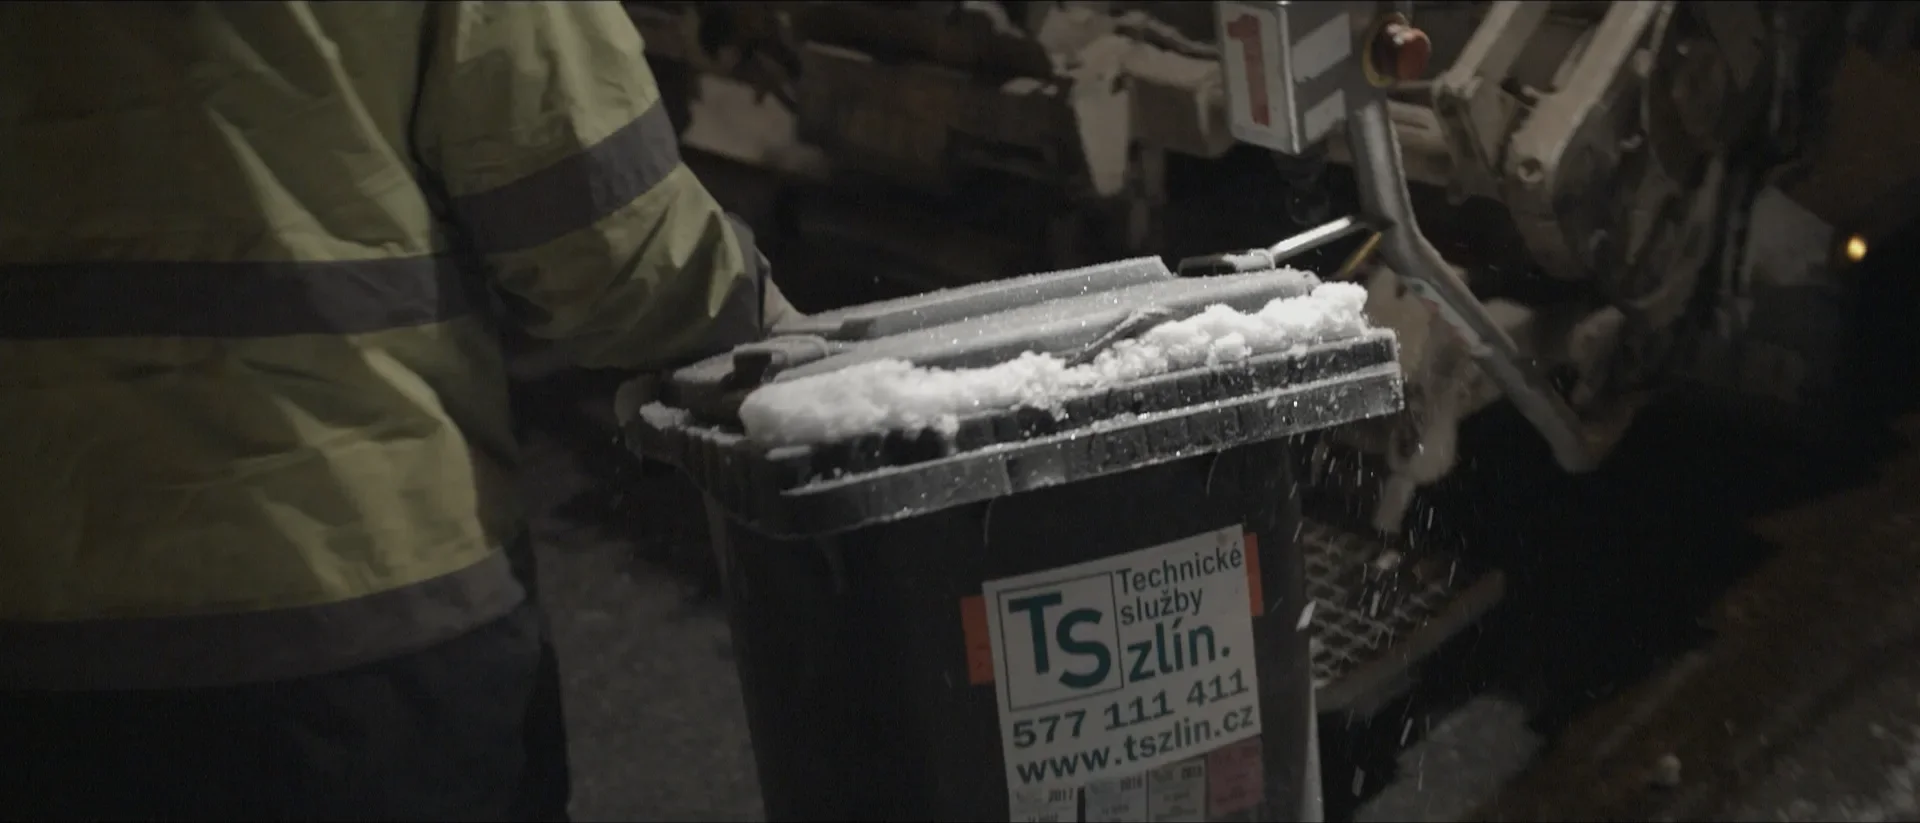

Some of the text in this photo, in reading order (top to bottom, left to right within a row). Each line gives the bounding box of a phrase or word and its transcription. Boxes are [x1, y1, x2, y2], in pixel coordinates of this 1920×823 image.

[1116, 542, 1242, 595] Technické
[1008, 590, 1112, 690] TS
[1120, 588, 1203, 626] služby
[1127, 618, 1231, 683] zlín.
[1013, 668, 1249, 749] 577 111 411
[1016, 705, 1255, 785] www.tszlin.cz
